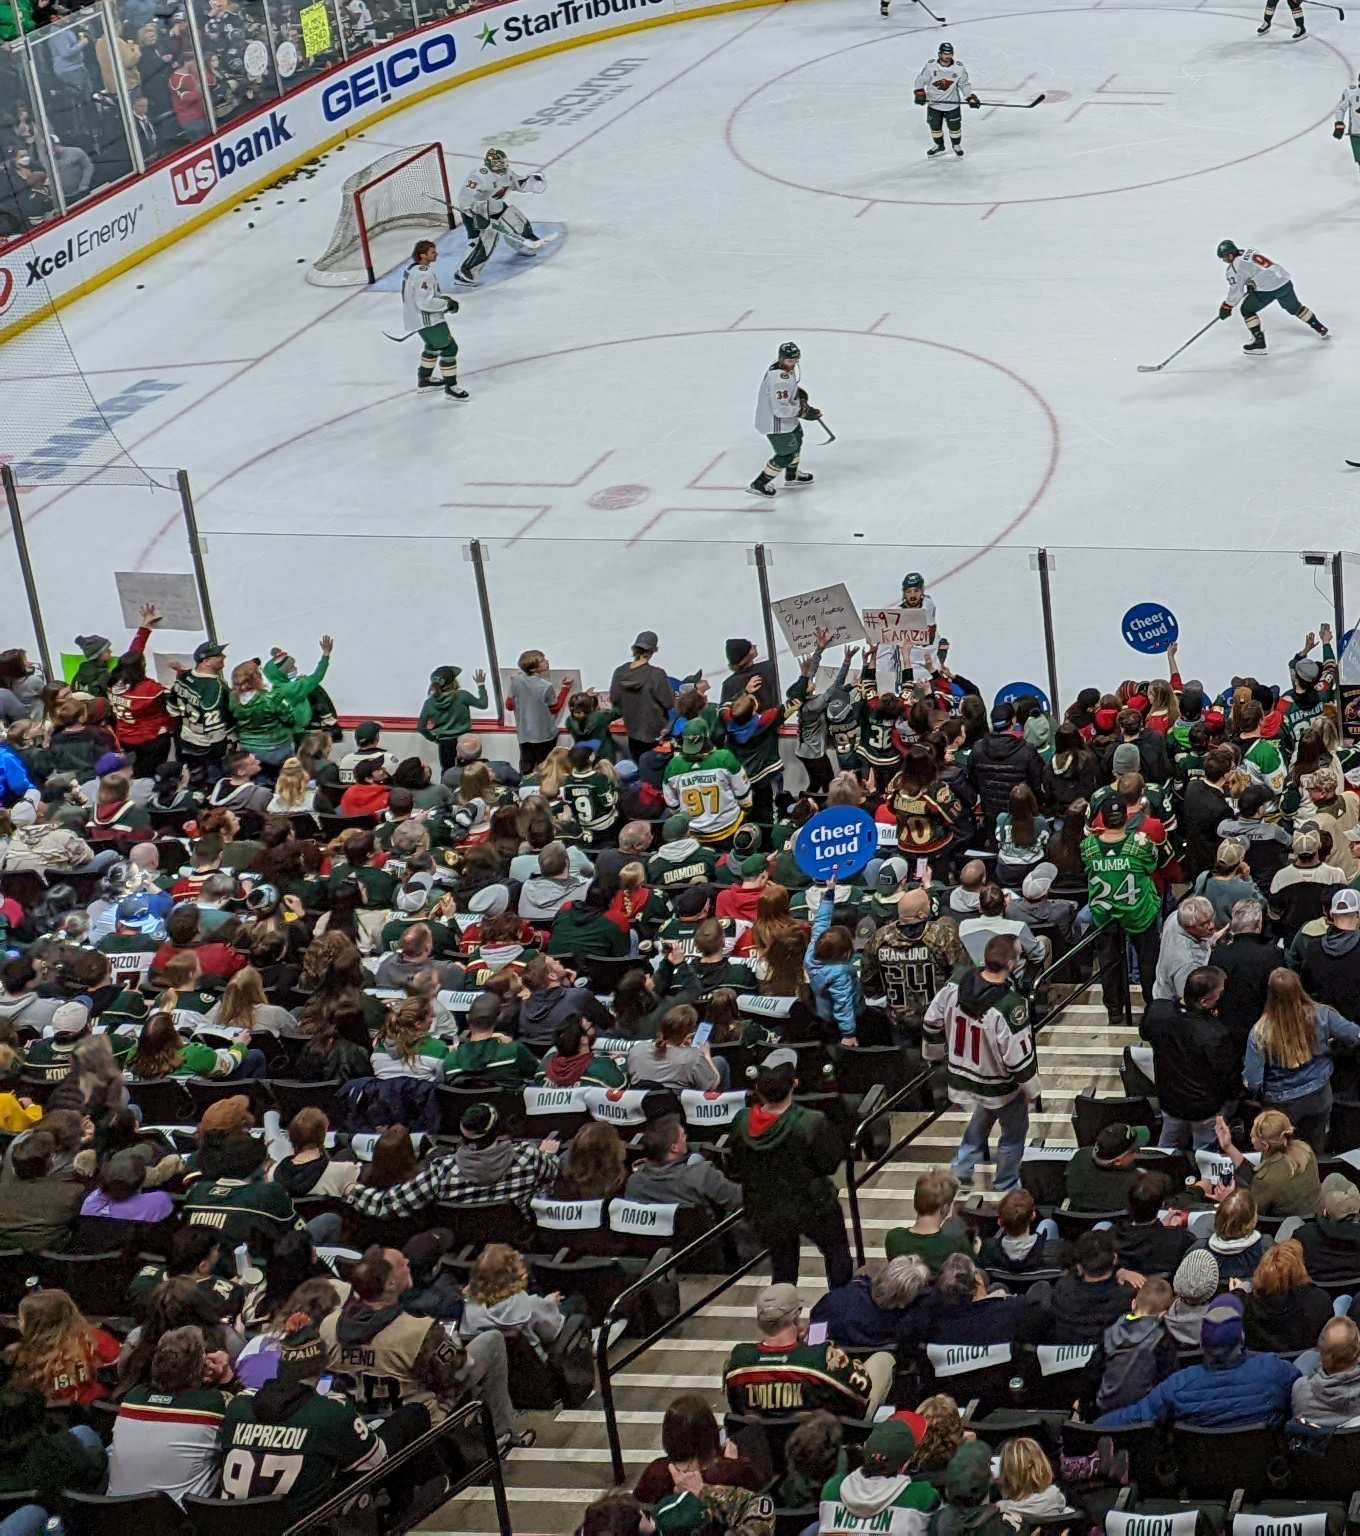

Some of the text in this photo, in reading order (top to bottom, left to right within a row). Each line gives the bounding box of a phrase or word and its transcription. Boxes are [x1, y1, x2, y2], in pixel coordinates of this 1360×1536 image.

[321, 33, 457, 123] GEICO
[26, 206, 139, 287] Xcel Energy
[1129, 612, 1165, 633] Cheer
[1137, 624, 1168, 642] Loud
[575, 795, 594, 819] 9
[679, 785, 720, 816] 97
[809, 816, 864, 846] Cheer
[815, 836, 859, 861] Loud
[1092, 855, 1131, 873] DUMBA
[1089, 872, 1138, 908] 24
[553, 1203, 586, 1221] KOIVU
[232, 1423, 307, 1450] KAPRIZOV
[222, 1448, 304, 1500] 97
